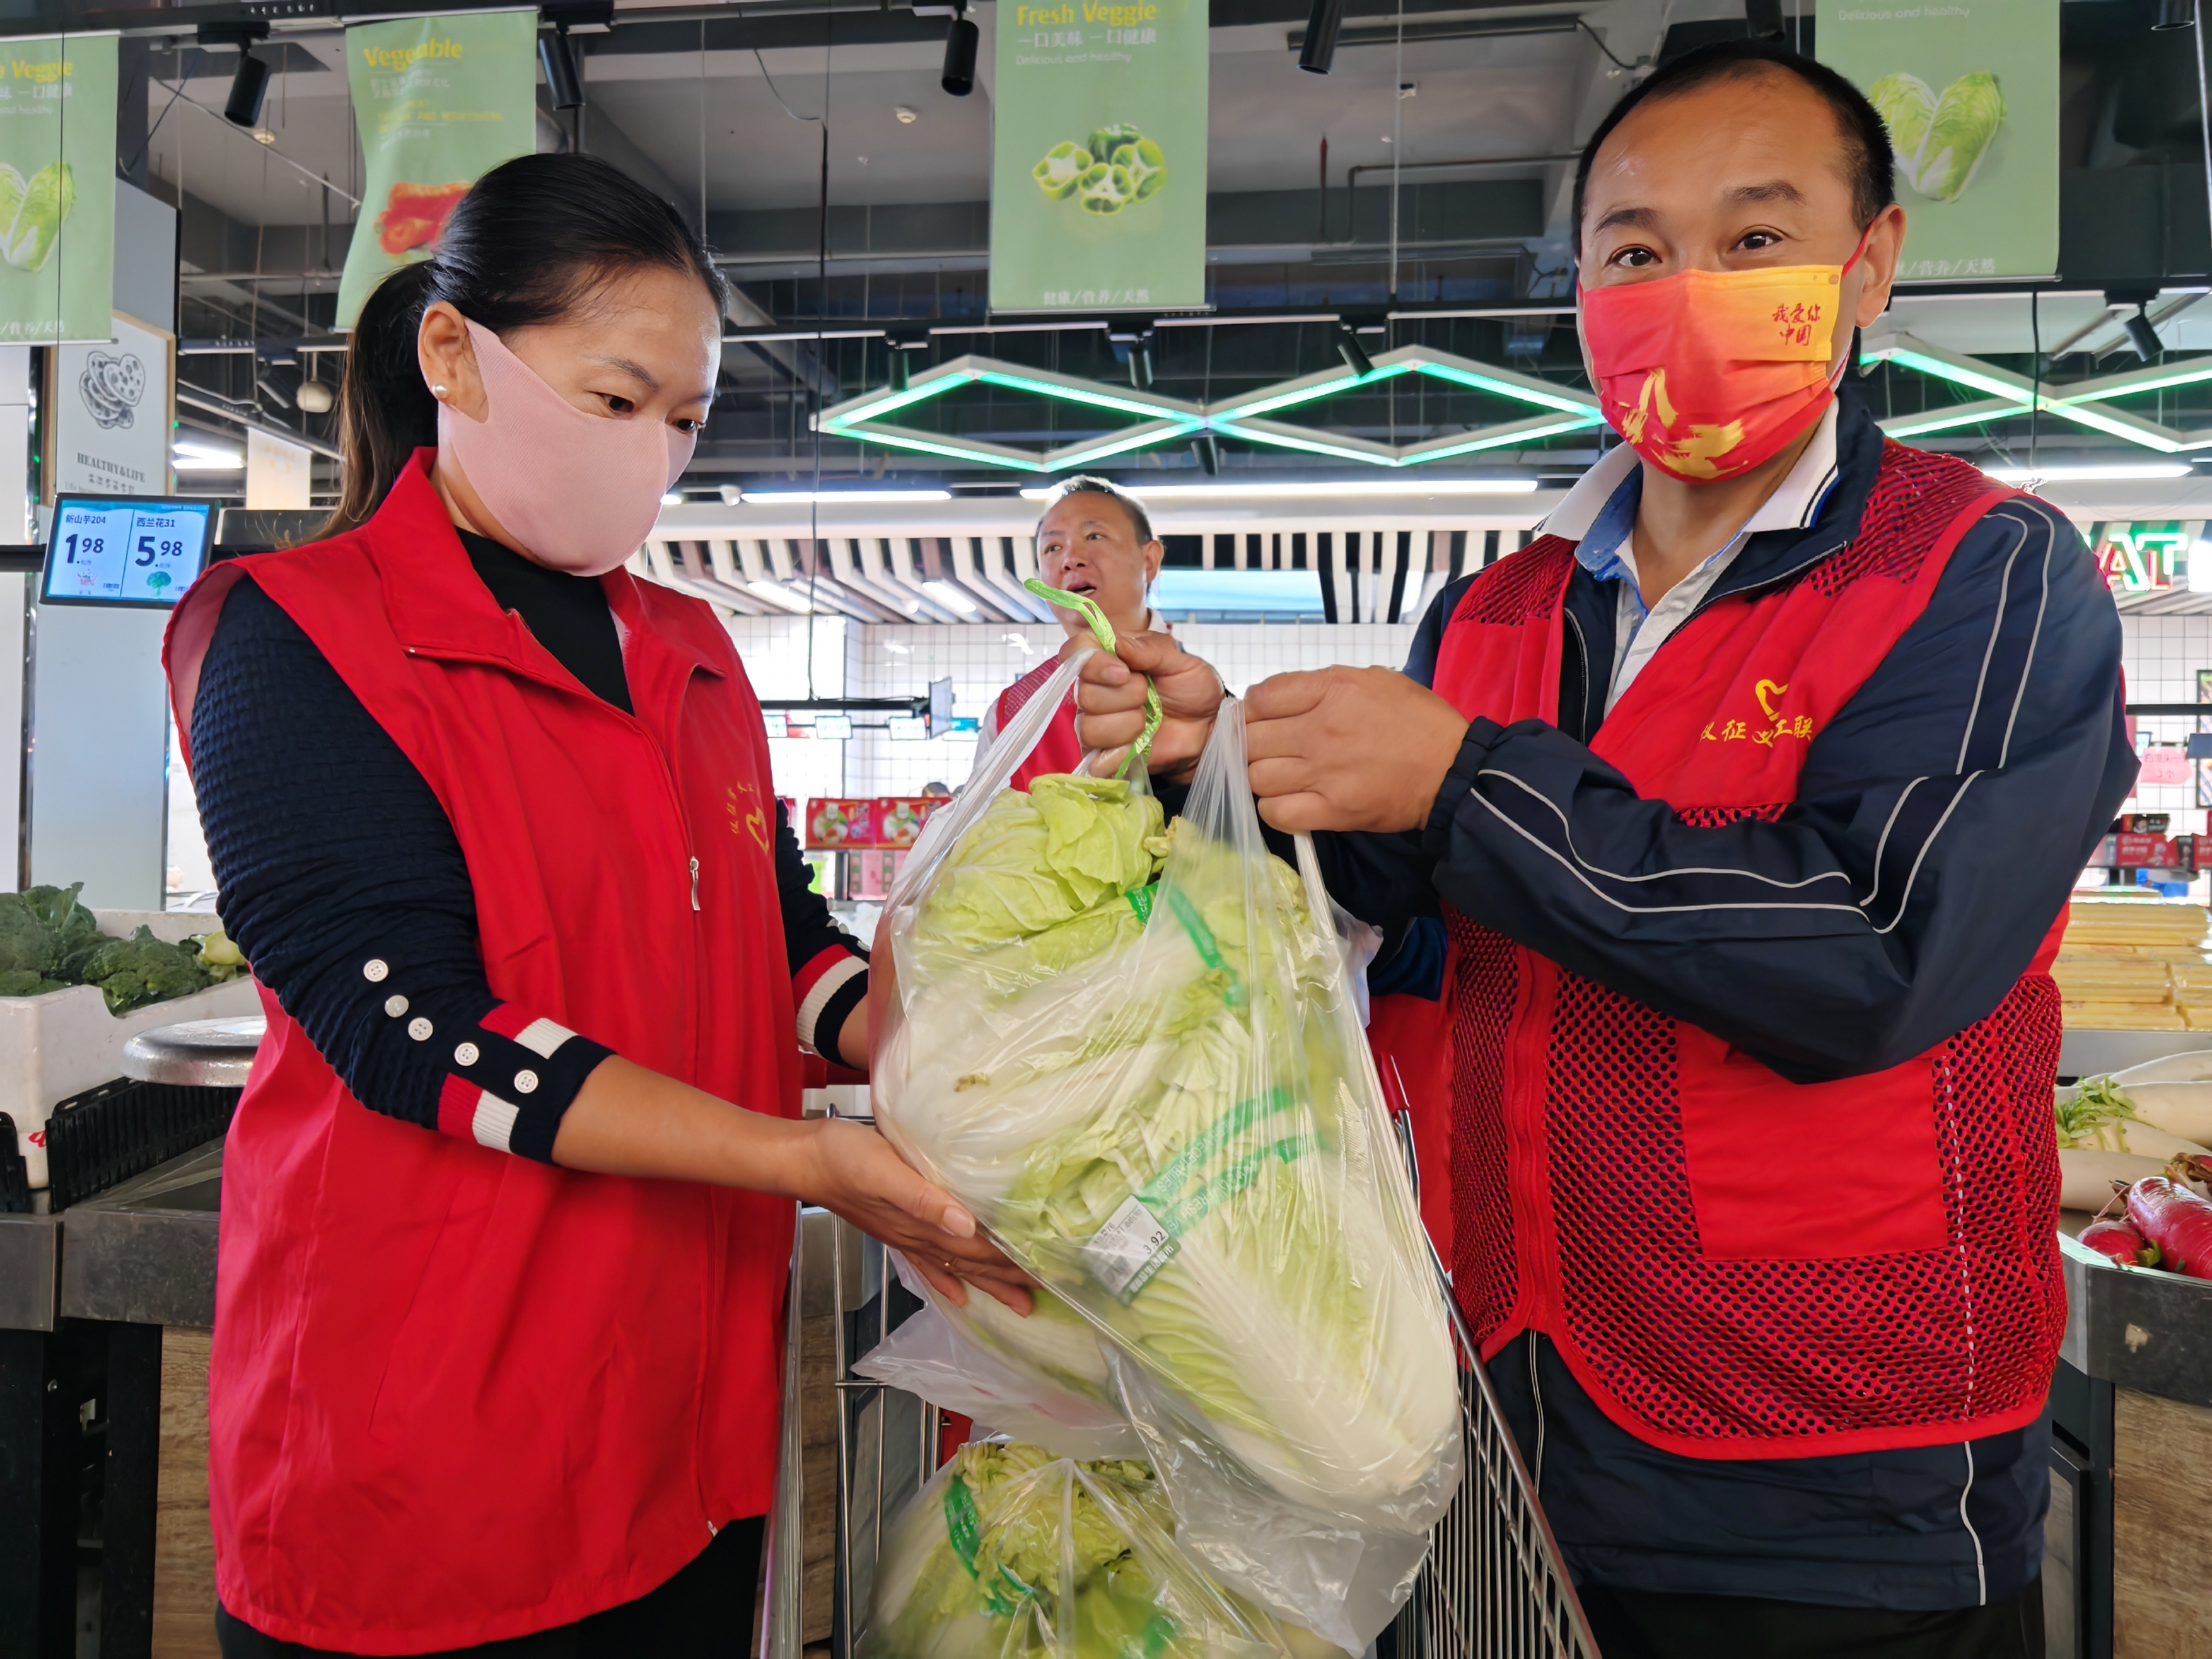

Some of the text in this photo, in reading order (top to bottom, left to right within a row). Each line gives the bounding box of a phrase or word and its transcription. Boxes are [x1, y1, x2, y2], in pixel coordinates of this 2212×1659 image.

[1017, 0, 1157, 26] Fresh Veggie
[1838, 5, 1970, 21] Delicious and healthy
[363, 38, 463, 72] Vegeable
[1779, 324, 1811, 346] 中国
[66, 515, 106, 524] 新山芋204
[136, 517, 175, 528] 西兰花31
[1143, 1230, 1166, 1255] 3.92
